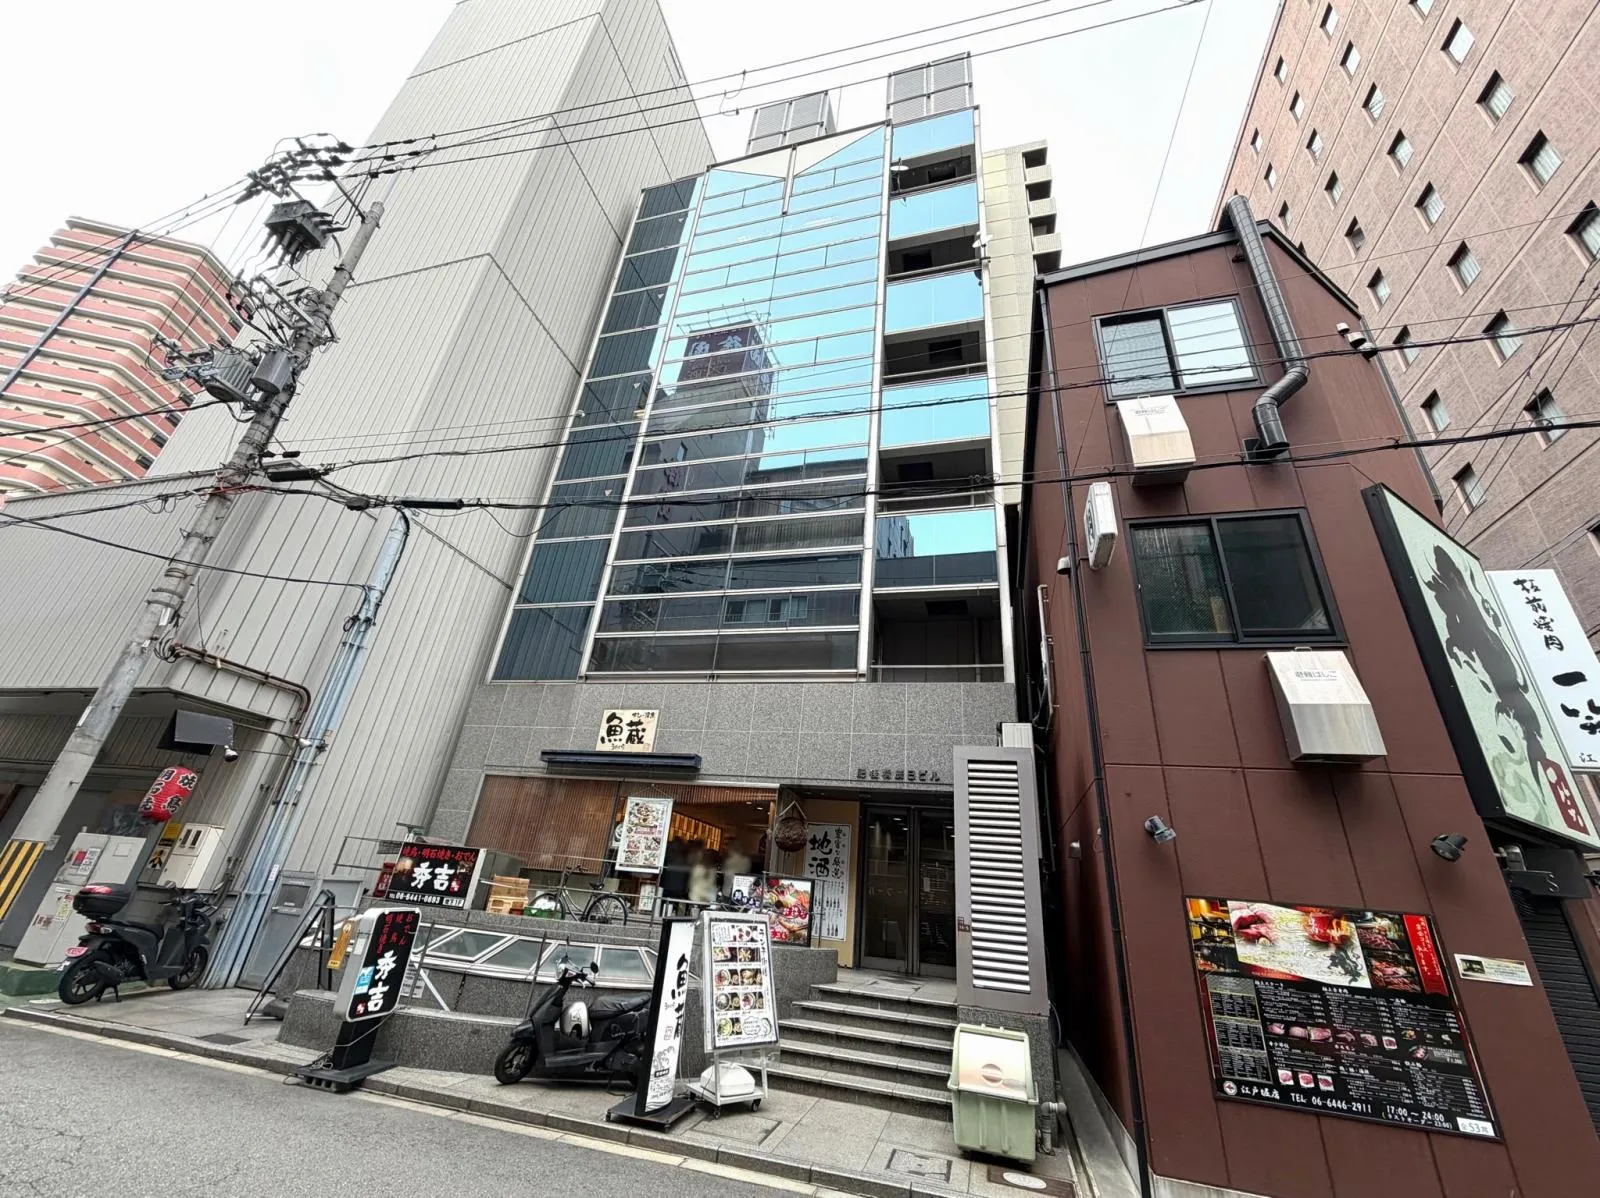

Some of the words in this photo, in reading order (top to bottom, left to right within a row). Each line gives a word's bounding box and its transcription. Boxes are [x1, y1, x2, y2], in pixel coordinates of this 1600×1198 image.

[600, 712, 647, 745] 魚蔵
[808, 830, 833, 878] 地酒
[411, 861, 455, 891] 秀吉
[366, 950, 398, 1012] 秀吉
[1290, 1092, 1307, 1104] TEL
[1311, 1095, 1373, 1114] 06-6446-2911
[1386, 1105, 1408, 1117] 17:00
[1422, 1110, 1445, 1122] 24:00
